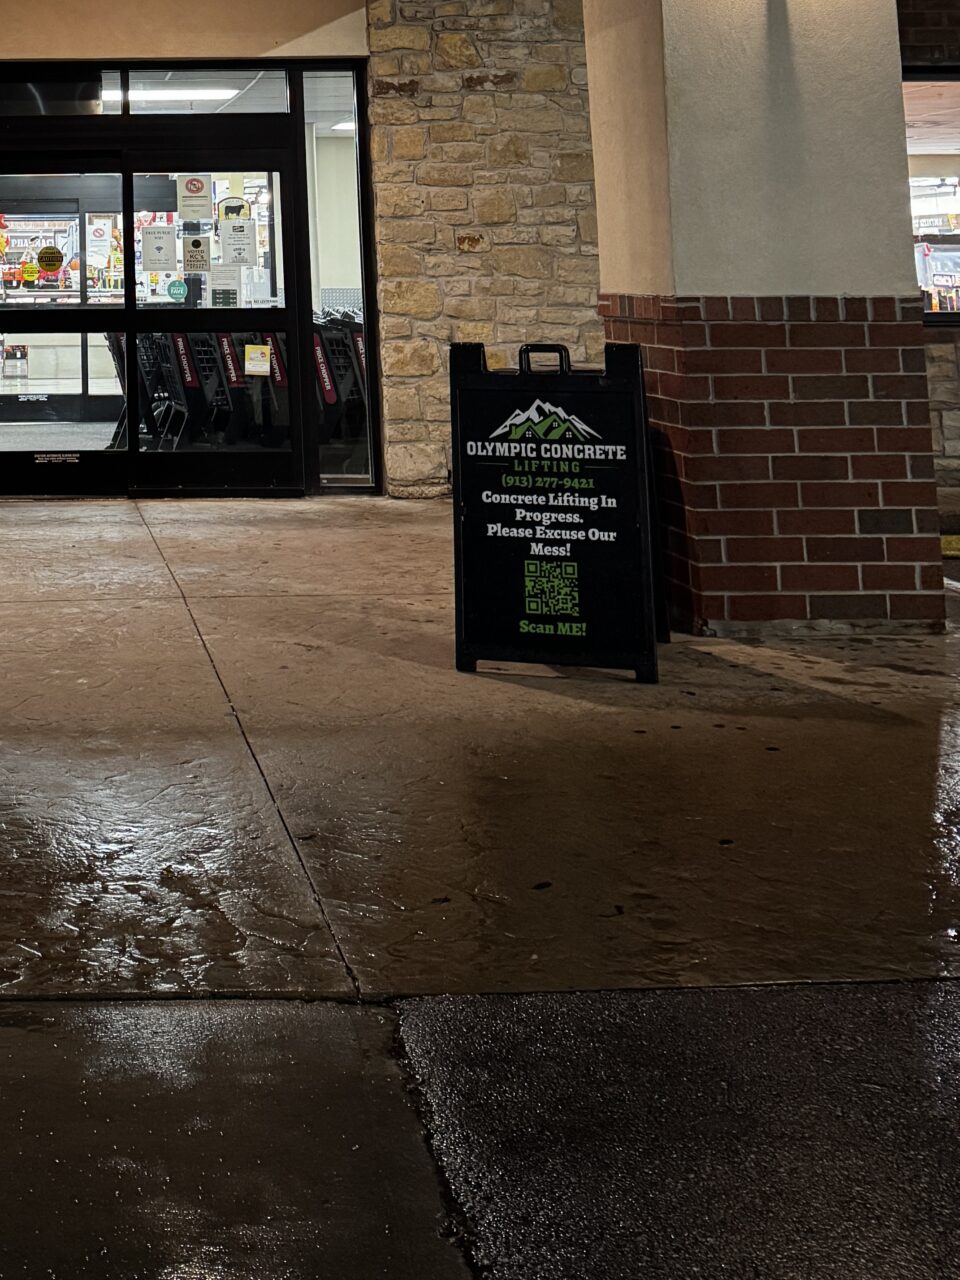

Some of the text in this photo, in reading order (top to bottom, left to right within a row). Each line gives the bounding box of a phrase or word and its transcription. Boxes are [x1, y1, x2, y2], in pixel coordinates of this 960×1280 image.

[466, 441, 627, 460] OLYMPIC CONCRETE
[514, 459, 580, 473] LIFTING
[501, 473, 595, 489] (913) 277-9421
[481, 490, 617, 510] Concrete Lifting In
[515, 508, 584, 525] Progress.
[486, 523, 617, 542] Please Excuse Our
[530, 542, 571, 556] Mess!
[519, 620, 587, 636] Scan ME!
